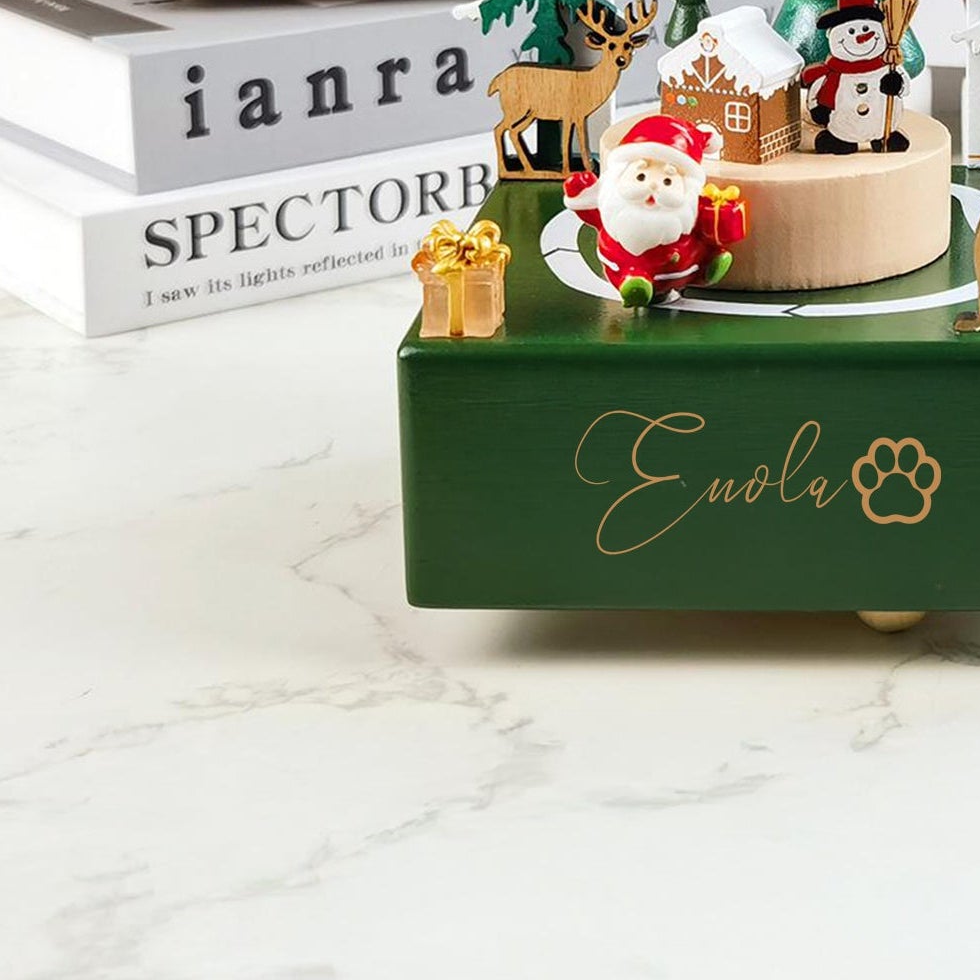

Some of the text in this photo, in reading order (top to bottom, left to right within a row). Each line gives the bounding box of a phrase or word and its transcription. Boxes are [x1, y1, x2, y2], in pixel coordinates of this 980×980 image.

[183, 46, 475, 139] ianra
[143, 162, 493, 269] SPECTORB
[145, 290, 154, 307] I
[161, 285, 199, 304] saw
[207, 278, 232, 295] its
[240, 267, 296, 288] lights
[301, 246, 384, 275] reflected
[391, 241, 409, 258] in
[574, 410, 848, 555] Enola
